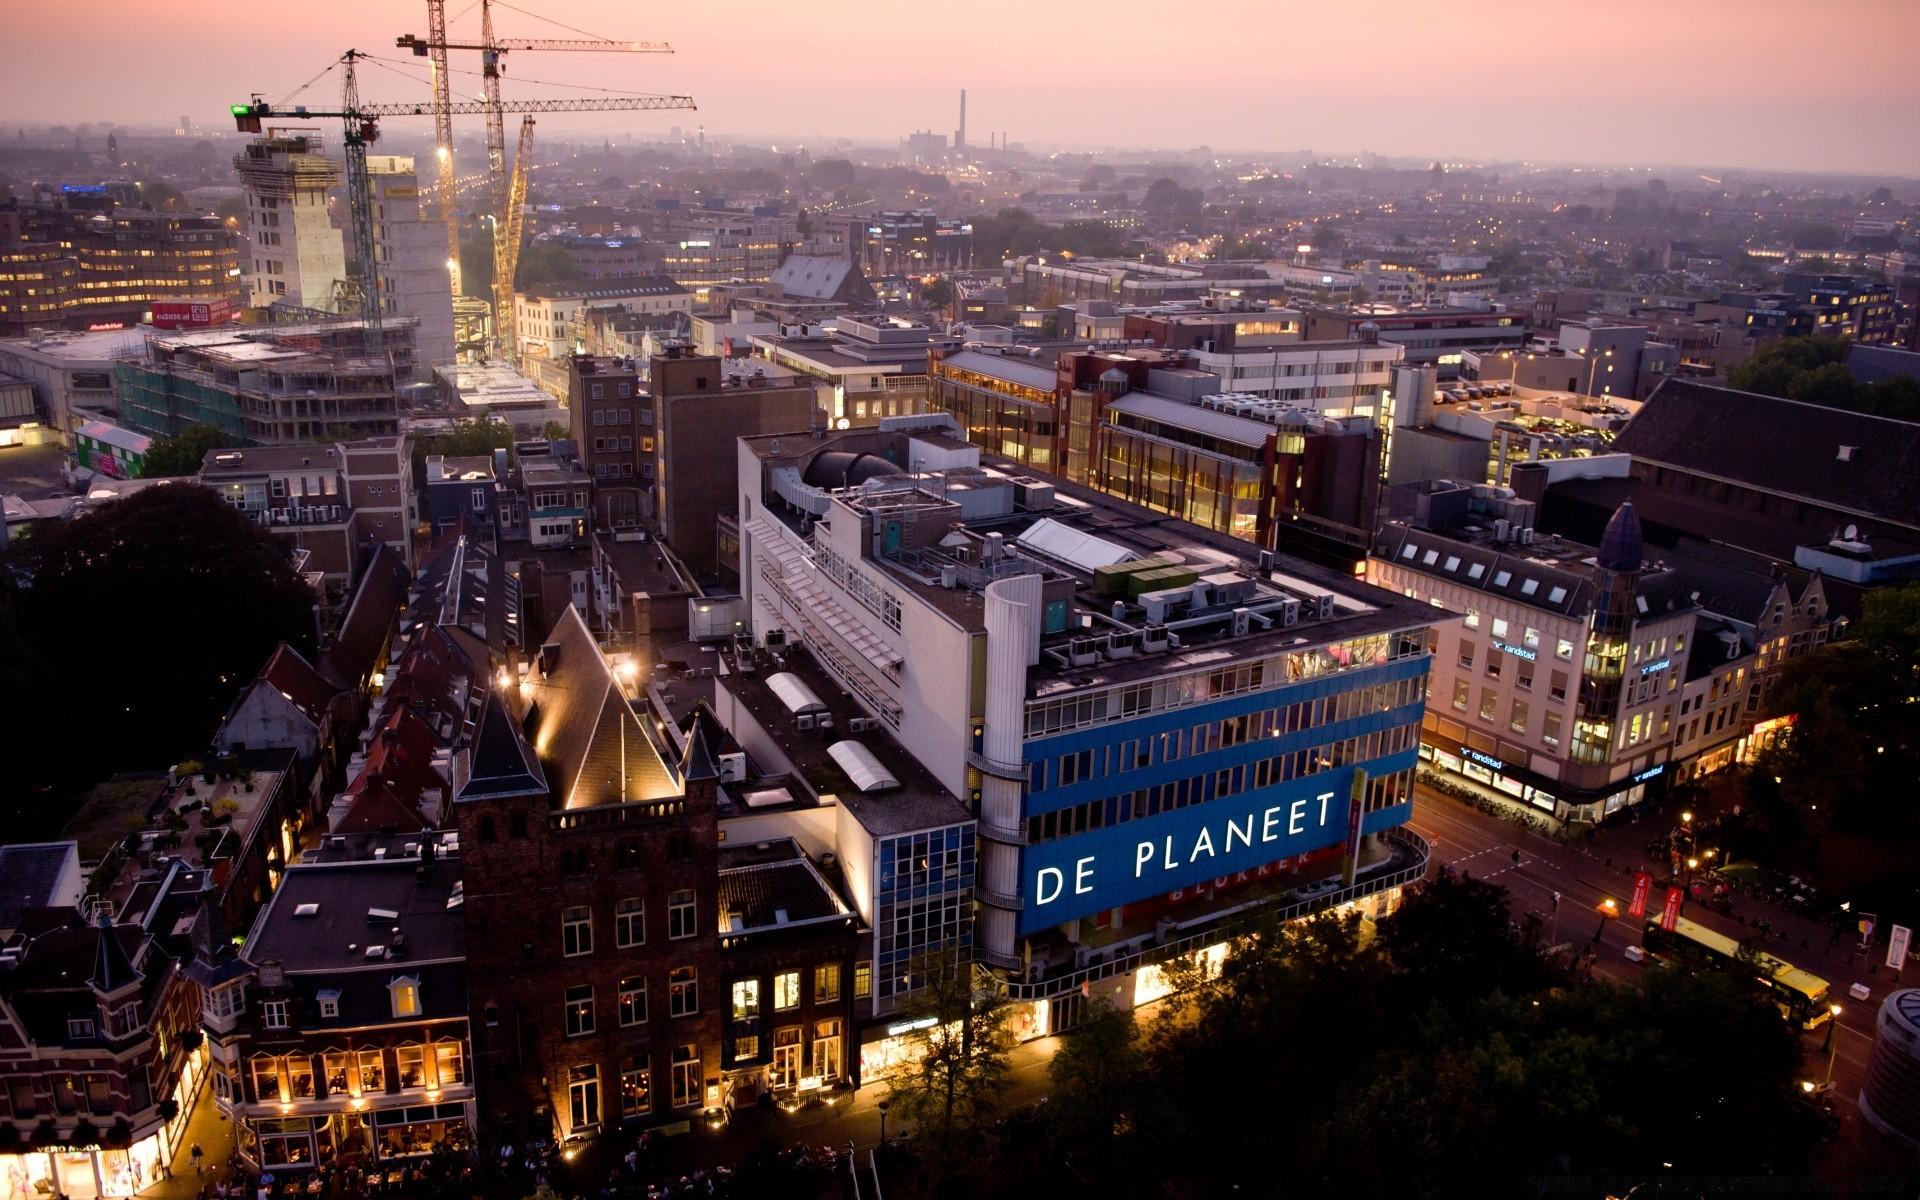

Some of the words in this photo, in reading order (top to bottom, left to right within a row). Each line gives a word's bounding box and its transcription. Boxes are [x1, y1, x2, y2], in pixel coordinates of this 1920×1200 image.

[1504, 645, 1536, 661] randstad
[1649, 659, 1671, 673] randstad
[1471, 751, 1503, 769] randstad
[1642, 764, 1664, 780] randstad
[1036, 856, 1095, 906] DE
[1135, 791, 1335, 878] PLANEET
